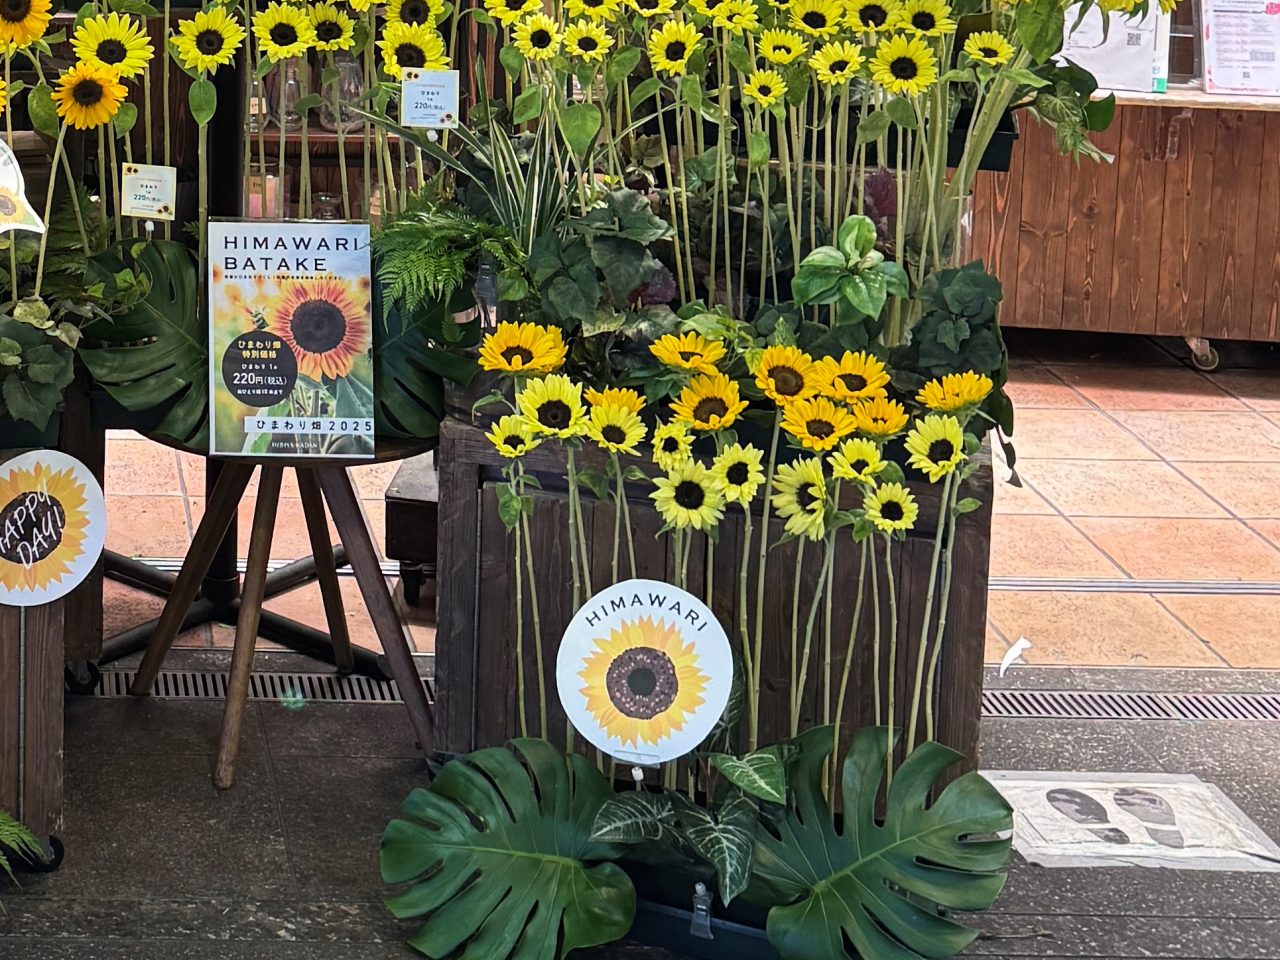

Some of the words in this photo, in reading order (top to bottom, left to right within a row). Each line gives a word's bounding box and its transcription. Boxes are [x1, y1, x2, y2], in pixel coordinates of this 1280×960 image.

[224, 236, 358, 251] HIMAWARI
[224, 257, 327, 271] BATAKE
[257, 420, 321, 431] ひまわり畑
[329, 421, 372, 432] 2025
[17, 506, 65, 569] DAY!
[585, 593, 708, 633] HIMAWARI
